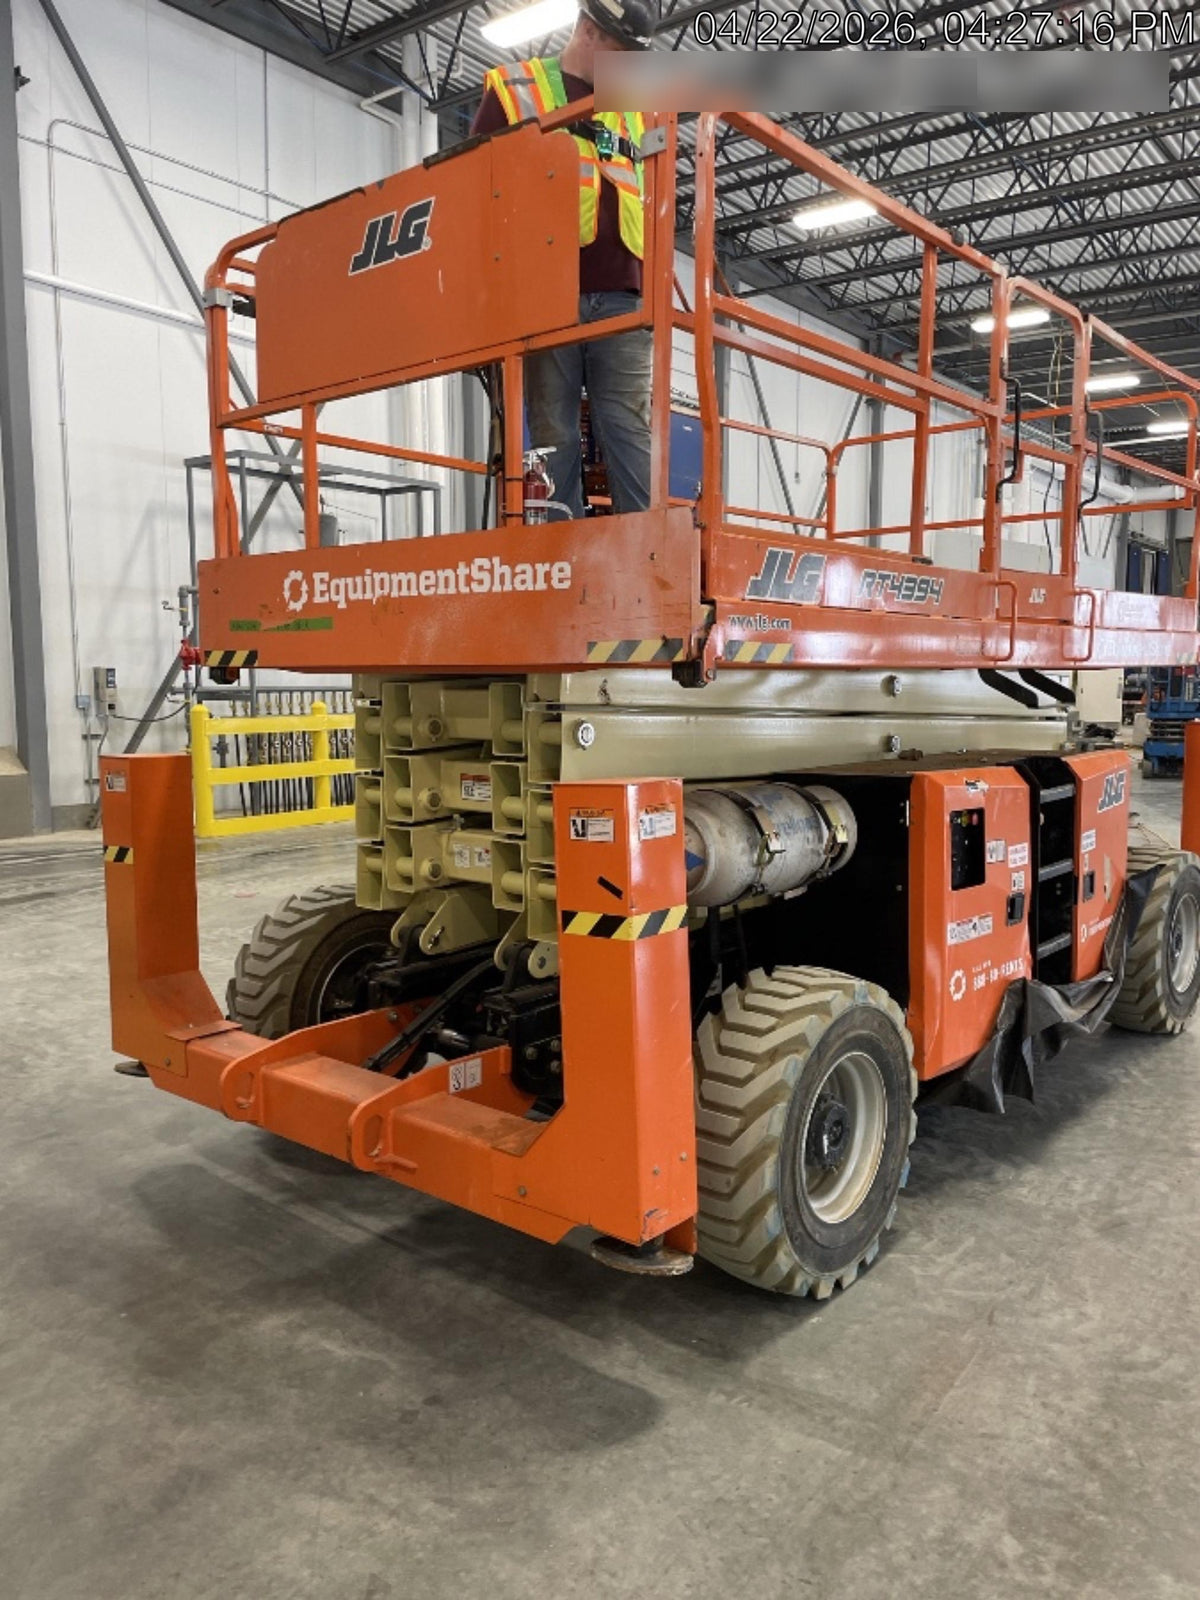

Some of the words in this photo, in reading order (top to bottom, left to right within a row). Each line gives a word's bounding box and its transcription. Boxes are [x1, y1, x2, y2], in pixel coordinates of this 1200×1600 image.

[348, 197, 436, 276] JLG
[312, 556, 572, 609] EquipmentShare
[744, 546, 828, 606] JLG
[856, 568, 944, 605] RT4394
